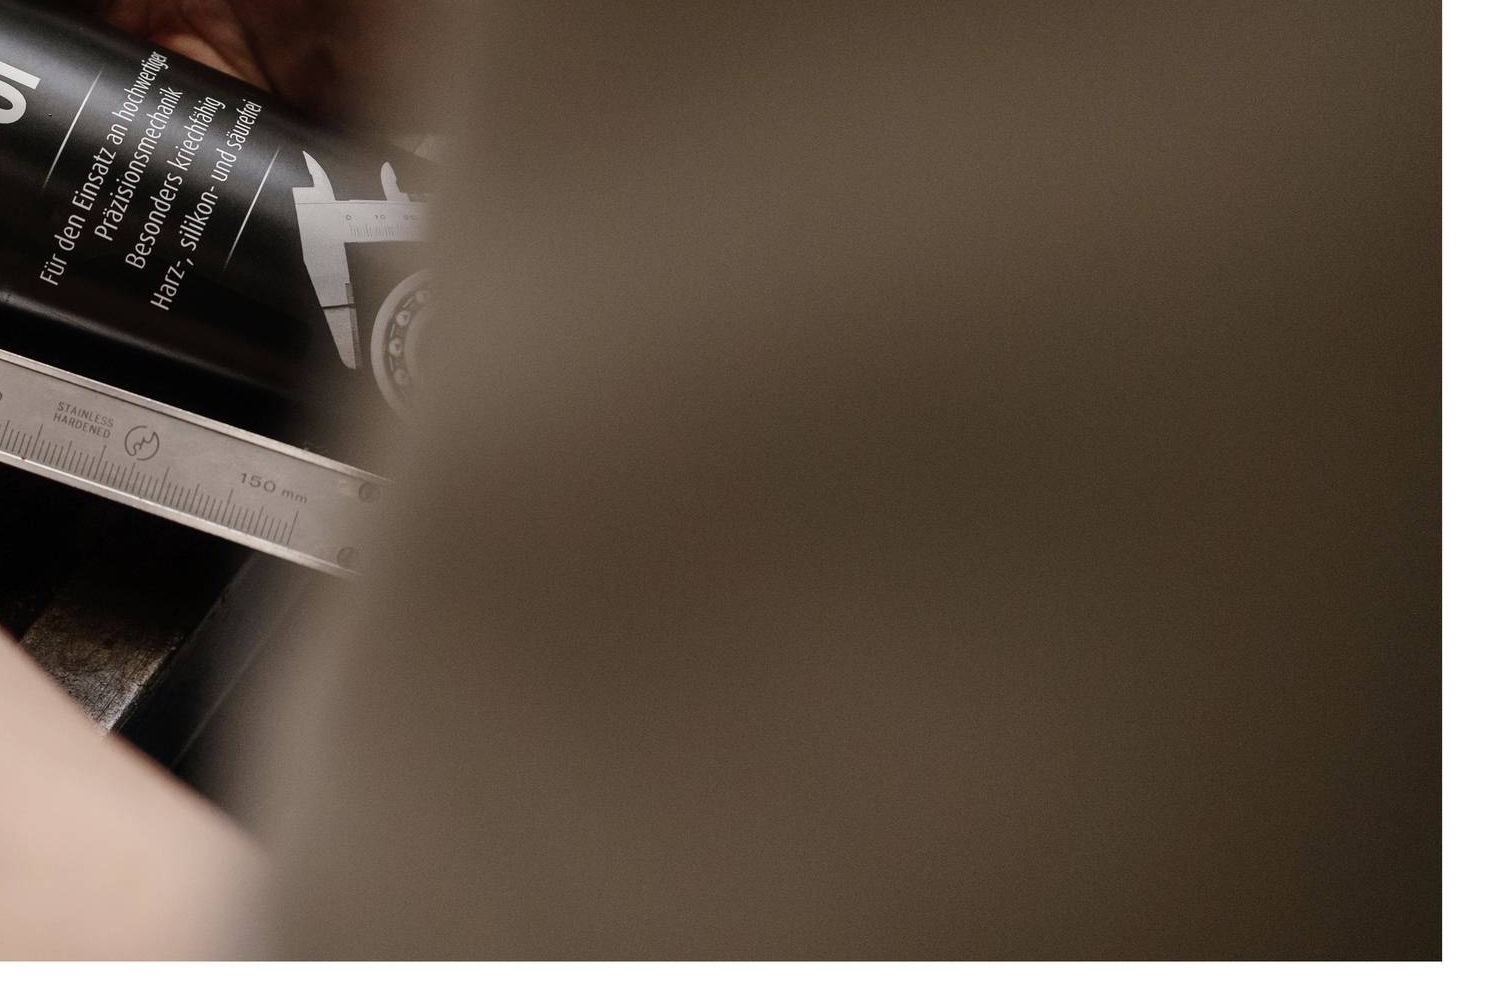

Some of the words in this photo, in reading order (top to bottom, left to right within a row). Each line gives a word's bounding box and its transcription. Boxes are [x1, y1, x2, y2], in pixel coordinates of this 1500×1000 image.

[112, 51, 169, 122] hochwertiger
[106, 123, 128, 145] an
[72, 147, 117, 211] Einsatz
[94, 86, 183, 241] Präzisionsmechanik
[125, 172, 183, 269] Besonders
[166, 96, 226, 171] kriechfähig
[150, 258, 194, 311] Harz-,
[179, 186, 218, 251] silikon-
[211, 148, 237, 182] und
[226, 98, 263, 150] säurefrei
[54, 214, 86, 251] den
[39, 254, 67, 286] Für
[53, 412, 111, 439] HARDENED
[57, 401, 114, 428] STAINLESS
[239, 472, 276, 493] 150
[282, 489, 308, 504] mm
